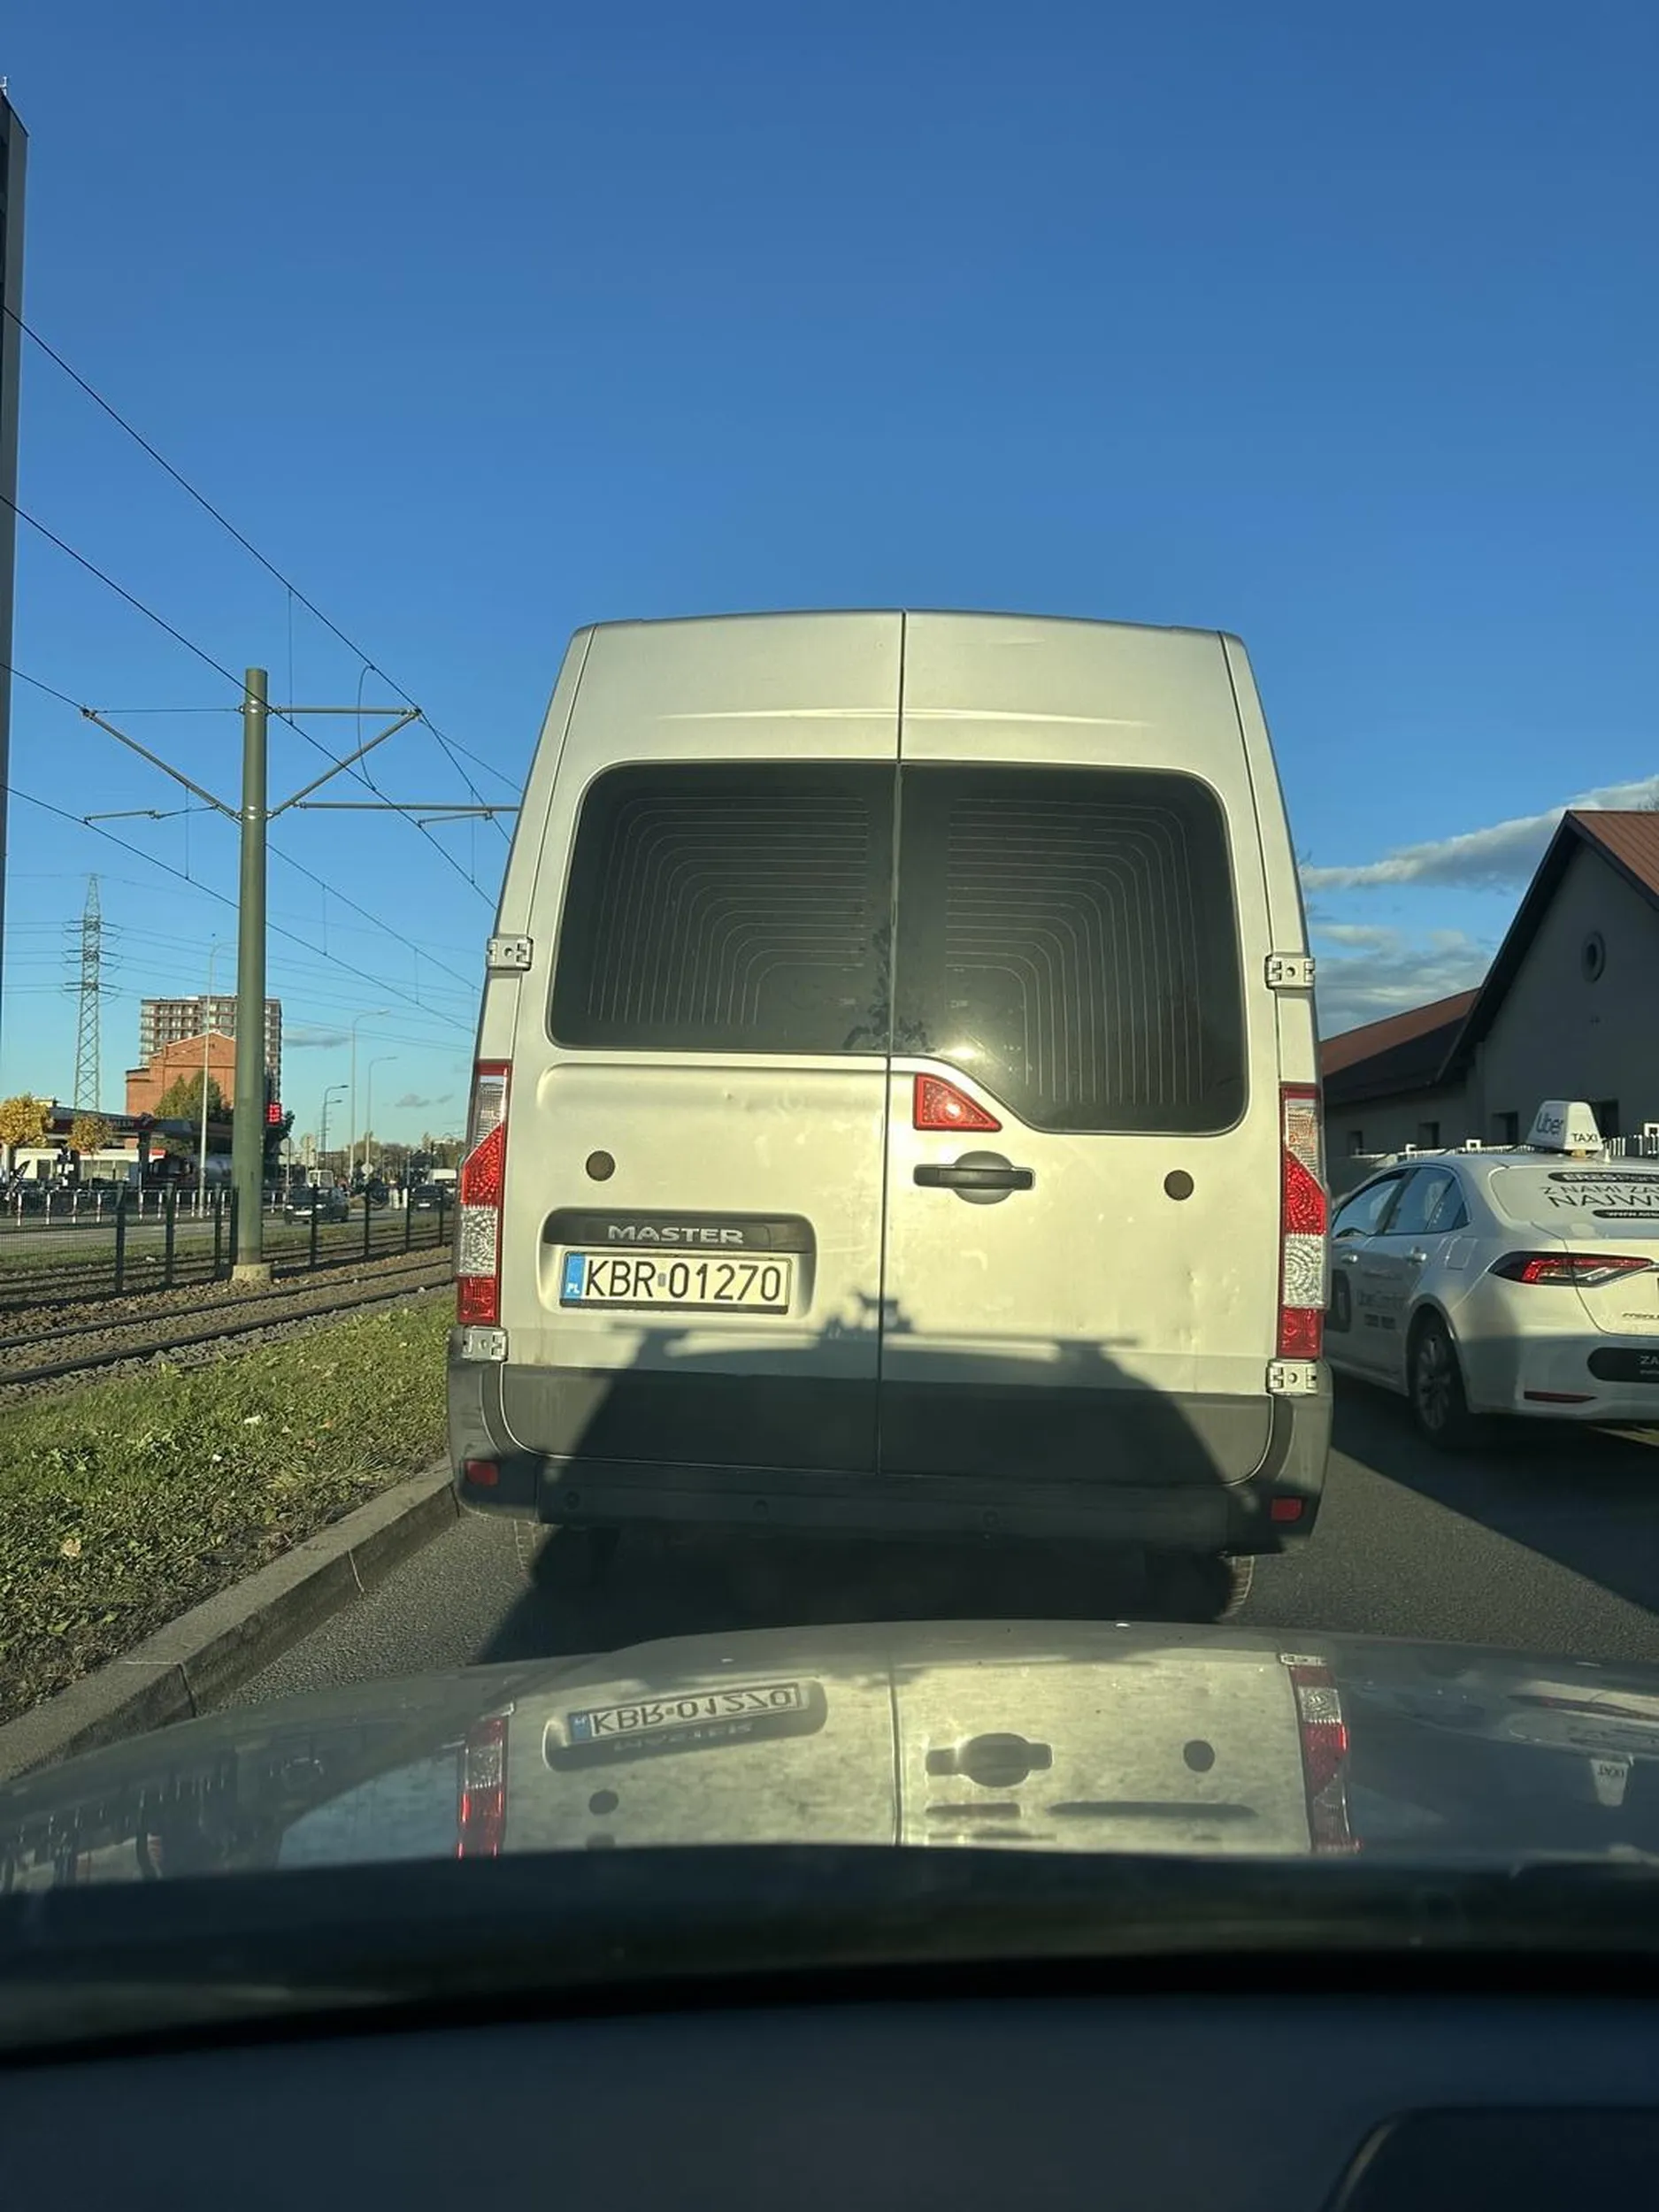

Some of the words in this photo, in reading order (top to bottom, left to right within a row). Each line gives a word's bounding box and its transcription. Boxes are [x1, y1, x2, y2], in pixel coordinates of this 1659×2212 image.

[1536, 1112, 1564, 1135] Uber
[1571, 1133, 1599, 1143] TAXI
[1624, 1185, 1659, 1194] ZA
[1548, 1194, 1659, 1208] NAJW
[608, 1225, 743, 1244] MASTER
[585, 1260, 657, 1298] KBR
[668, 1262, 781, 1302] 01270
